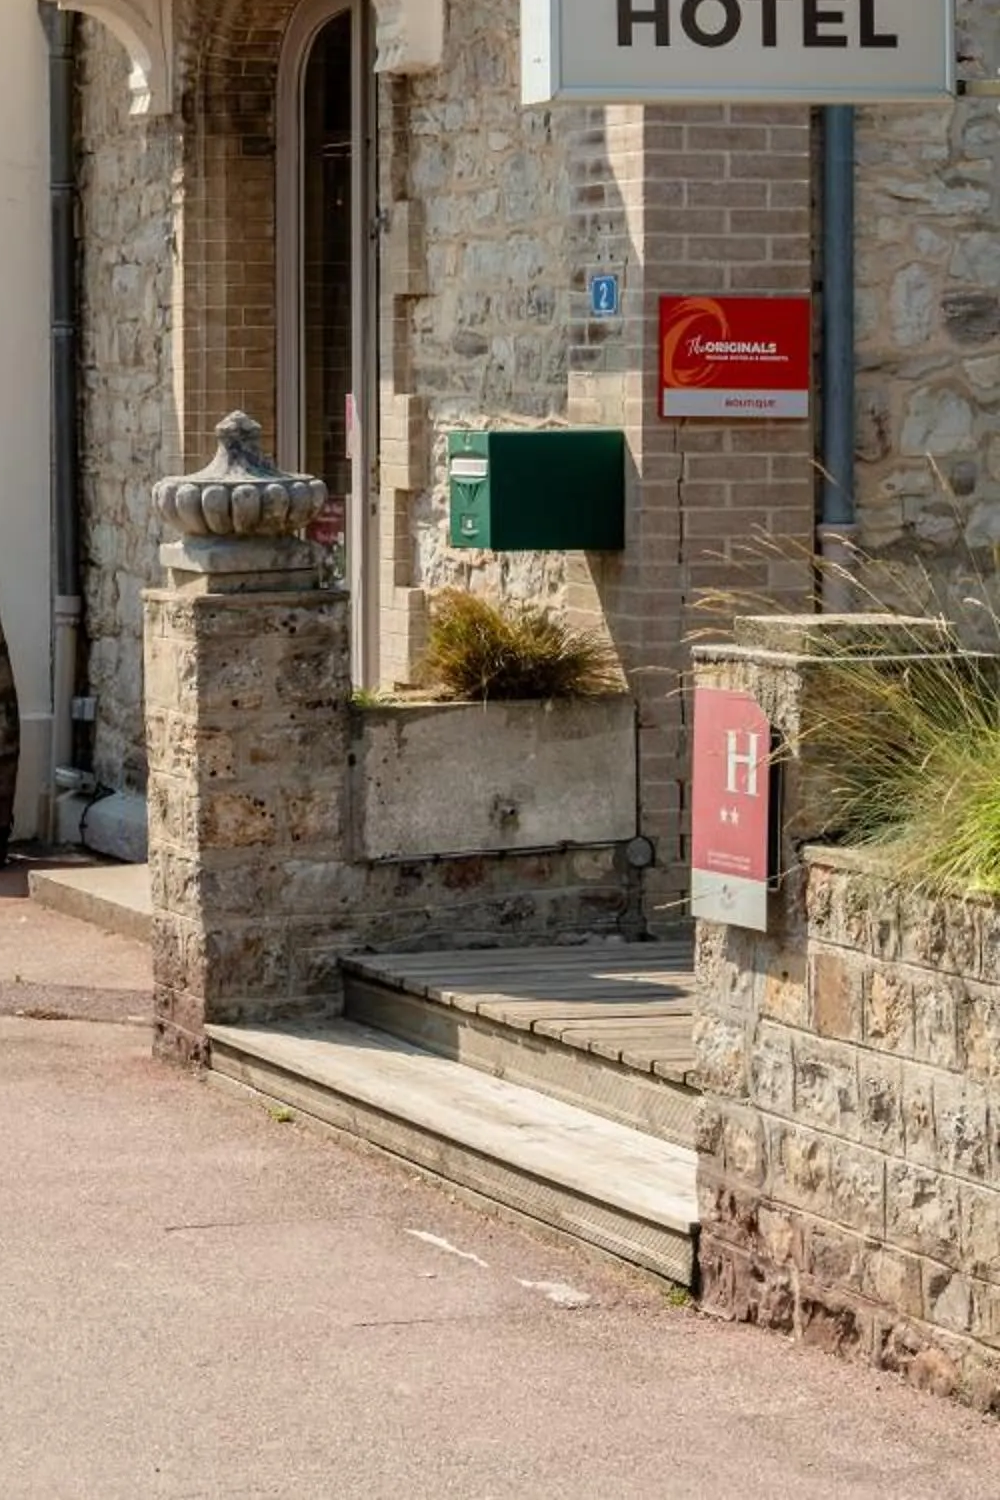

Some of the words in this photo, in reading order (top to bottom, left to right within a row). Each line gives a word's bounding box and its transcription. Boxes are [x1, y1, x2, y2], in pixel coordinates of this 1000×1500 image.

[599, 282, 609, 309] 2
[705, 341, 777, 353] ORIGINALS
[724, 729, 760, 797] H
